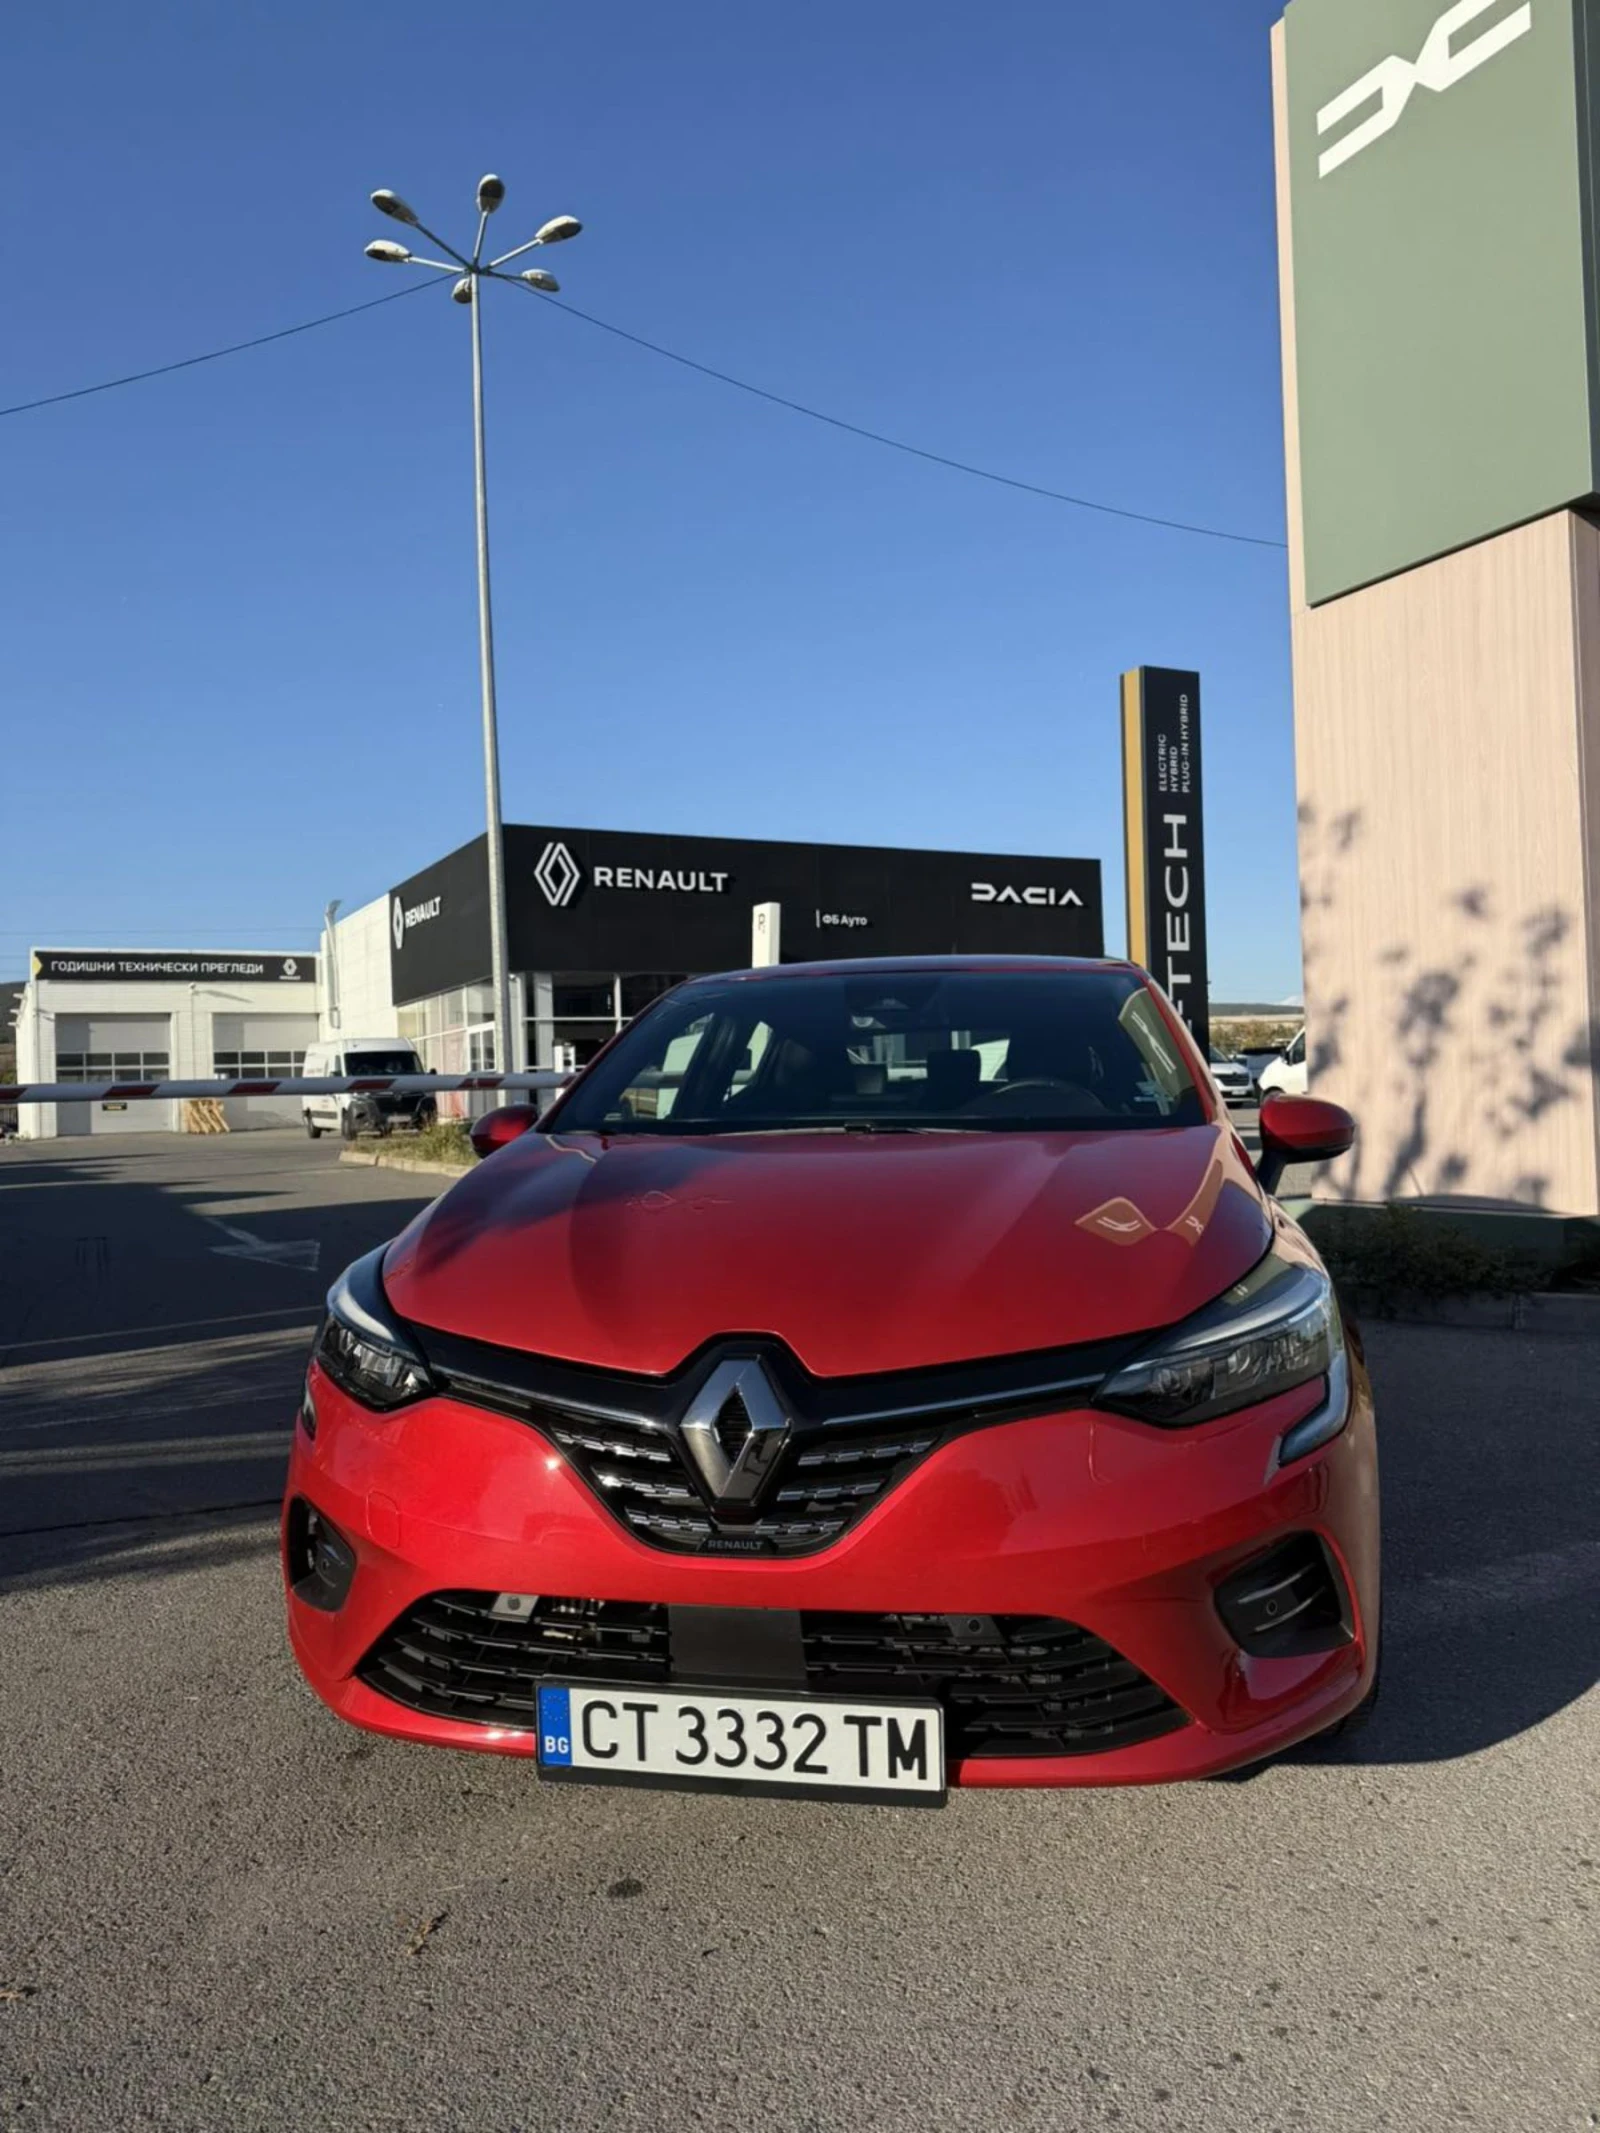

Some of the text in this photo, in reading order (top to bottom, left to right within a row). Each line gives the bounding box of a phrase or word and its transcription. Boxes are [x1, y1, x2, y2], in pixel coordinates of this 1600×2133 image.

[1179, 694, 1190, 793] PLUG-IN HYBRID
[1158, 733, 1168, 792] ELECTRIC
[1169, 746, 1179, 792] HYBRID
[593, 866, 729, 893] RENAULT
[971, 882, 1084, 906] DACIA
[405, 896, 441, 929] RENAULT
[822, 914, 868, 928] ФБ Ауто
[1163, 813, 1193, 1034] -TECH
[50, 960, 264, 975] ГОДИШНИ ТЕХНИЧЕСКИ ПРЕГЛЕДИ
[707, 1539, 764, 1551] RENAULT
[544, 1735, 569, 1755] BG
[581, 1699, 928, 1781] CT 3332 TM
